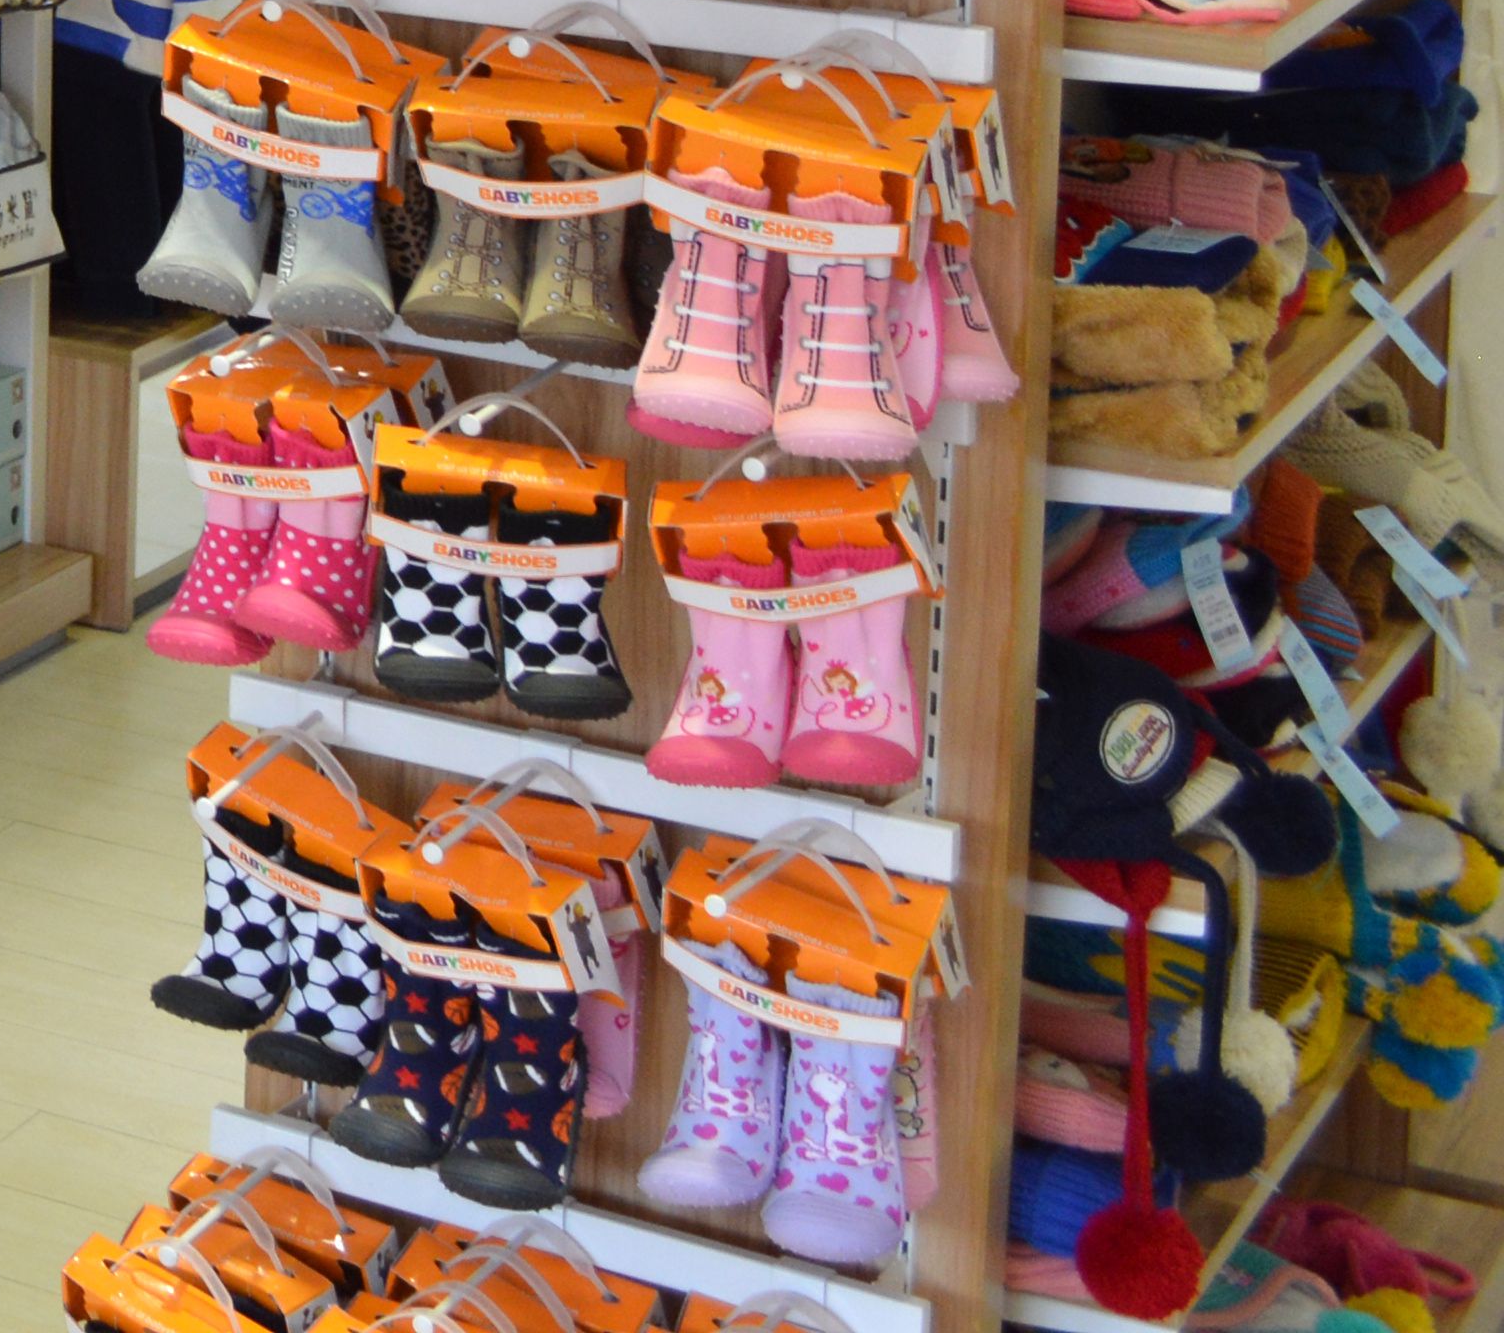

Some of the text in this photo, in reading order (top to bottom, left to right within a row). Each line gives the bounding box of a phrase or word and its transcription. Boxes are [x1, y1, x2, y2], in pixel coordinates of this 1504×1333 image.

[211, 124, 321, 170] BABYSHOES
[478, 185, 600, 206] BABYSHOES
[704, 206, 835, 247] BABYSHOES
[207, 468, 312, 493] BABYSHOES
[431, 541, 558, 572] BABYSHOES
[729, 587, 857, 612] BABYSHOES
[227, 841, 322, 904] BABYSHOES
[406, 950, 517, 981] BABYSHOES
[717, 977, 840, 1033] BABYSHOES
